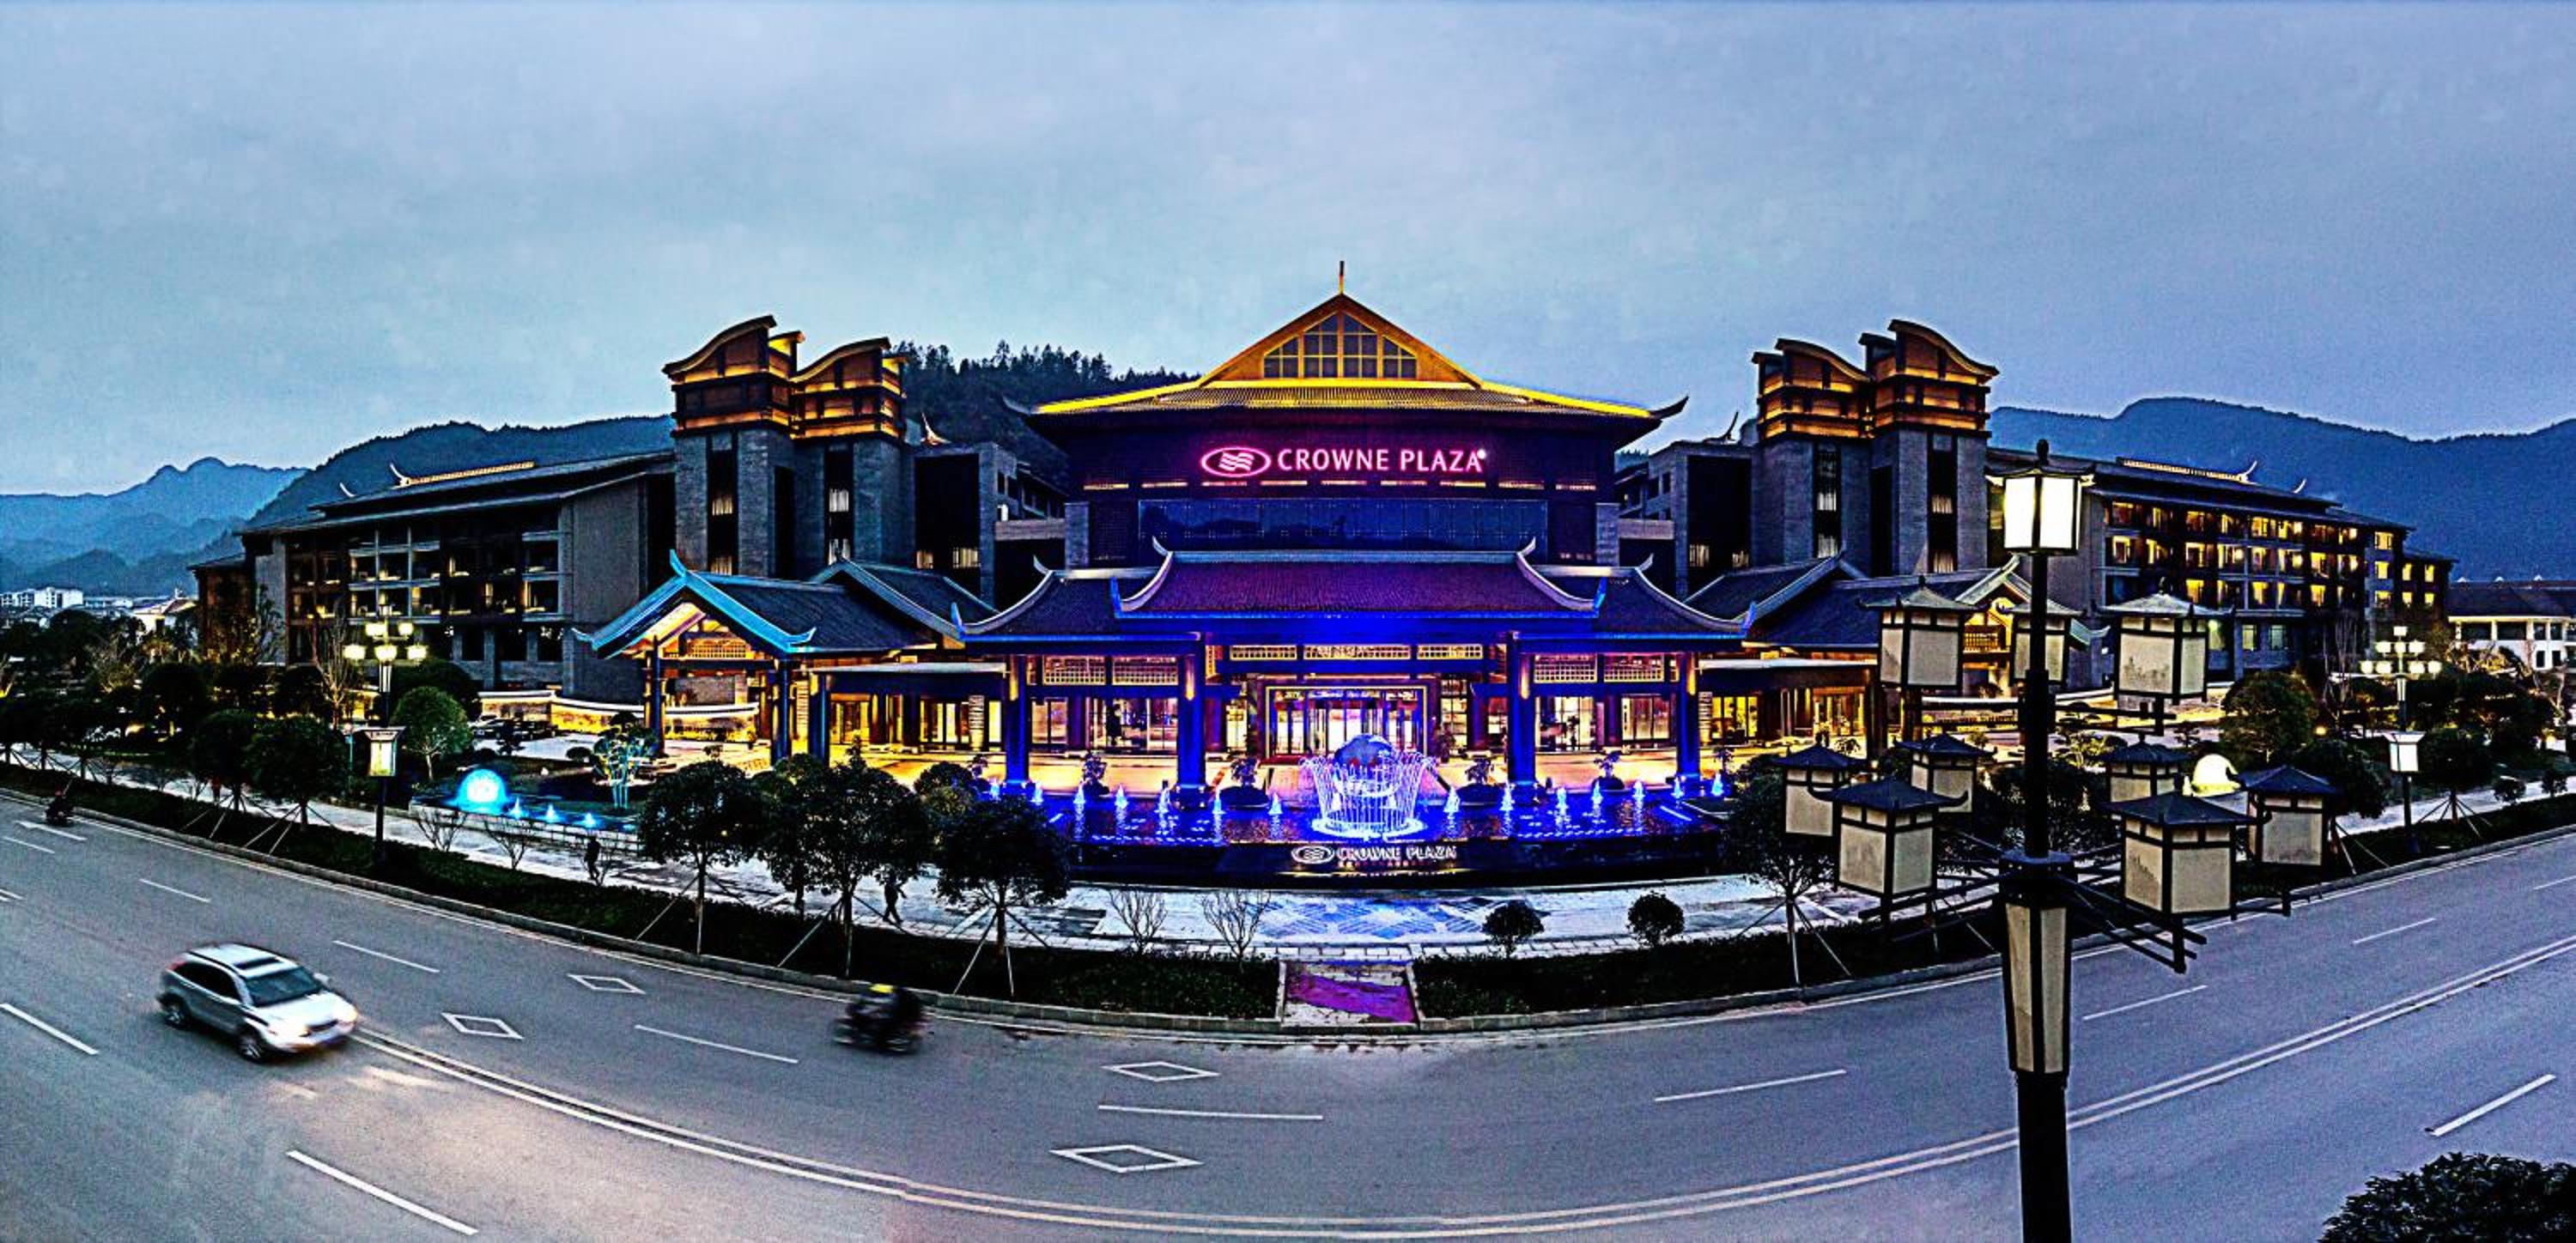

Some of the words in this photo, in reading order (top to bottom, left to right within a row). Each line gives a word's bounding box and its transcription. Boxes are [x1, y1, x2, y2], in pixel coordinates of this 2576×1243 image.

[1277, 448, 1389, 471] CROWNE
[1400, 448, 1483, 471] PLAZA
[1337, 846, 1401, 860] CROWNE
[1406, 846, 1457, 859] PLAZA
